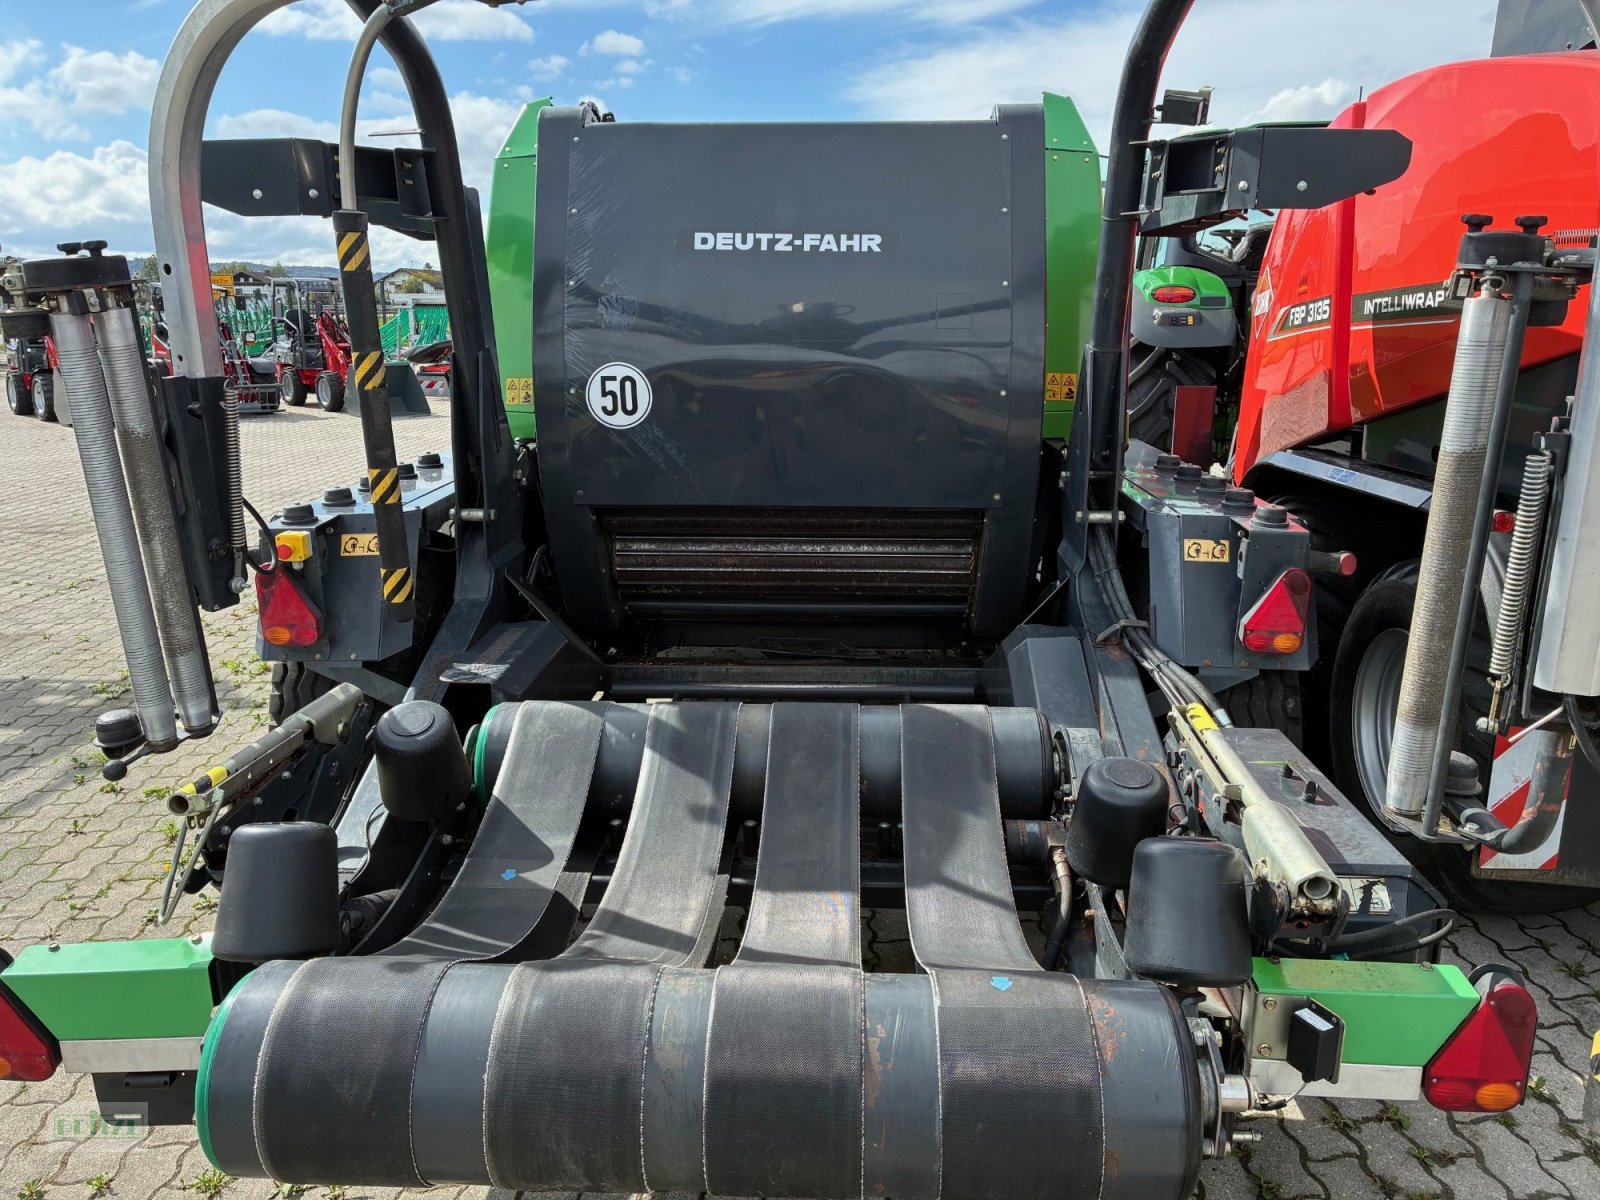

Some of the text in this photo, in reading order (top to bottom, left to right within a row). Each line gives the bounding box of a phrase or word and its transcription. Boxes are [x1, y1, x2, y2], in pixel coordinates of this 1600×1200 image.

[694, 232, 882, 252] DEUTZ-FAHR
[1289, 298, 1331, 327] FBP 3135
[1363, 290, 1445, 315] INTELLIWRAP
[600, 375, 638, 416] 50
